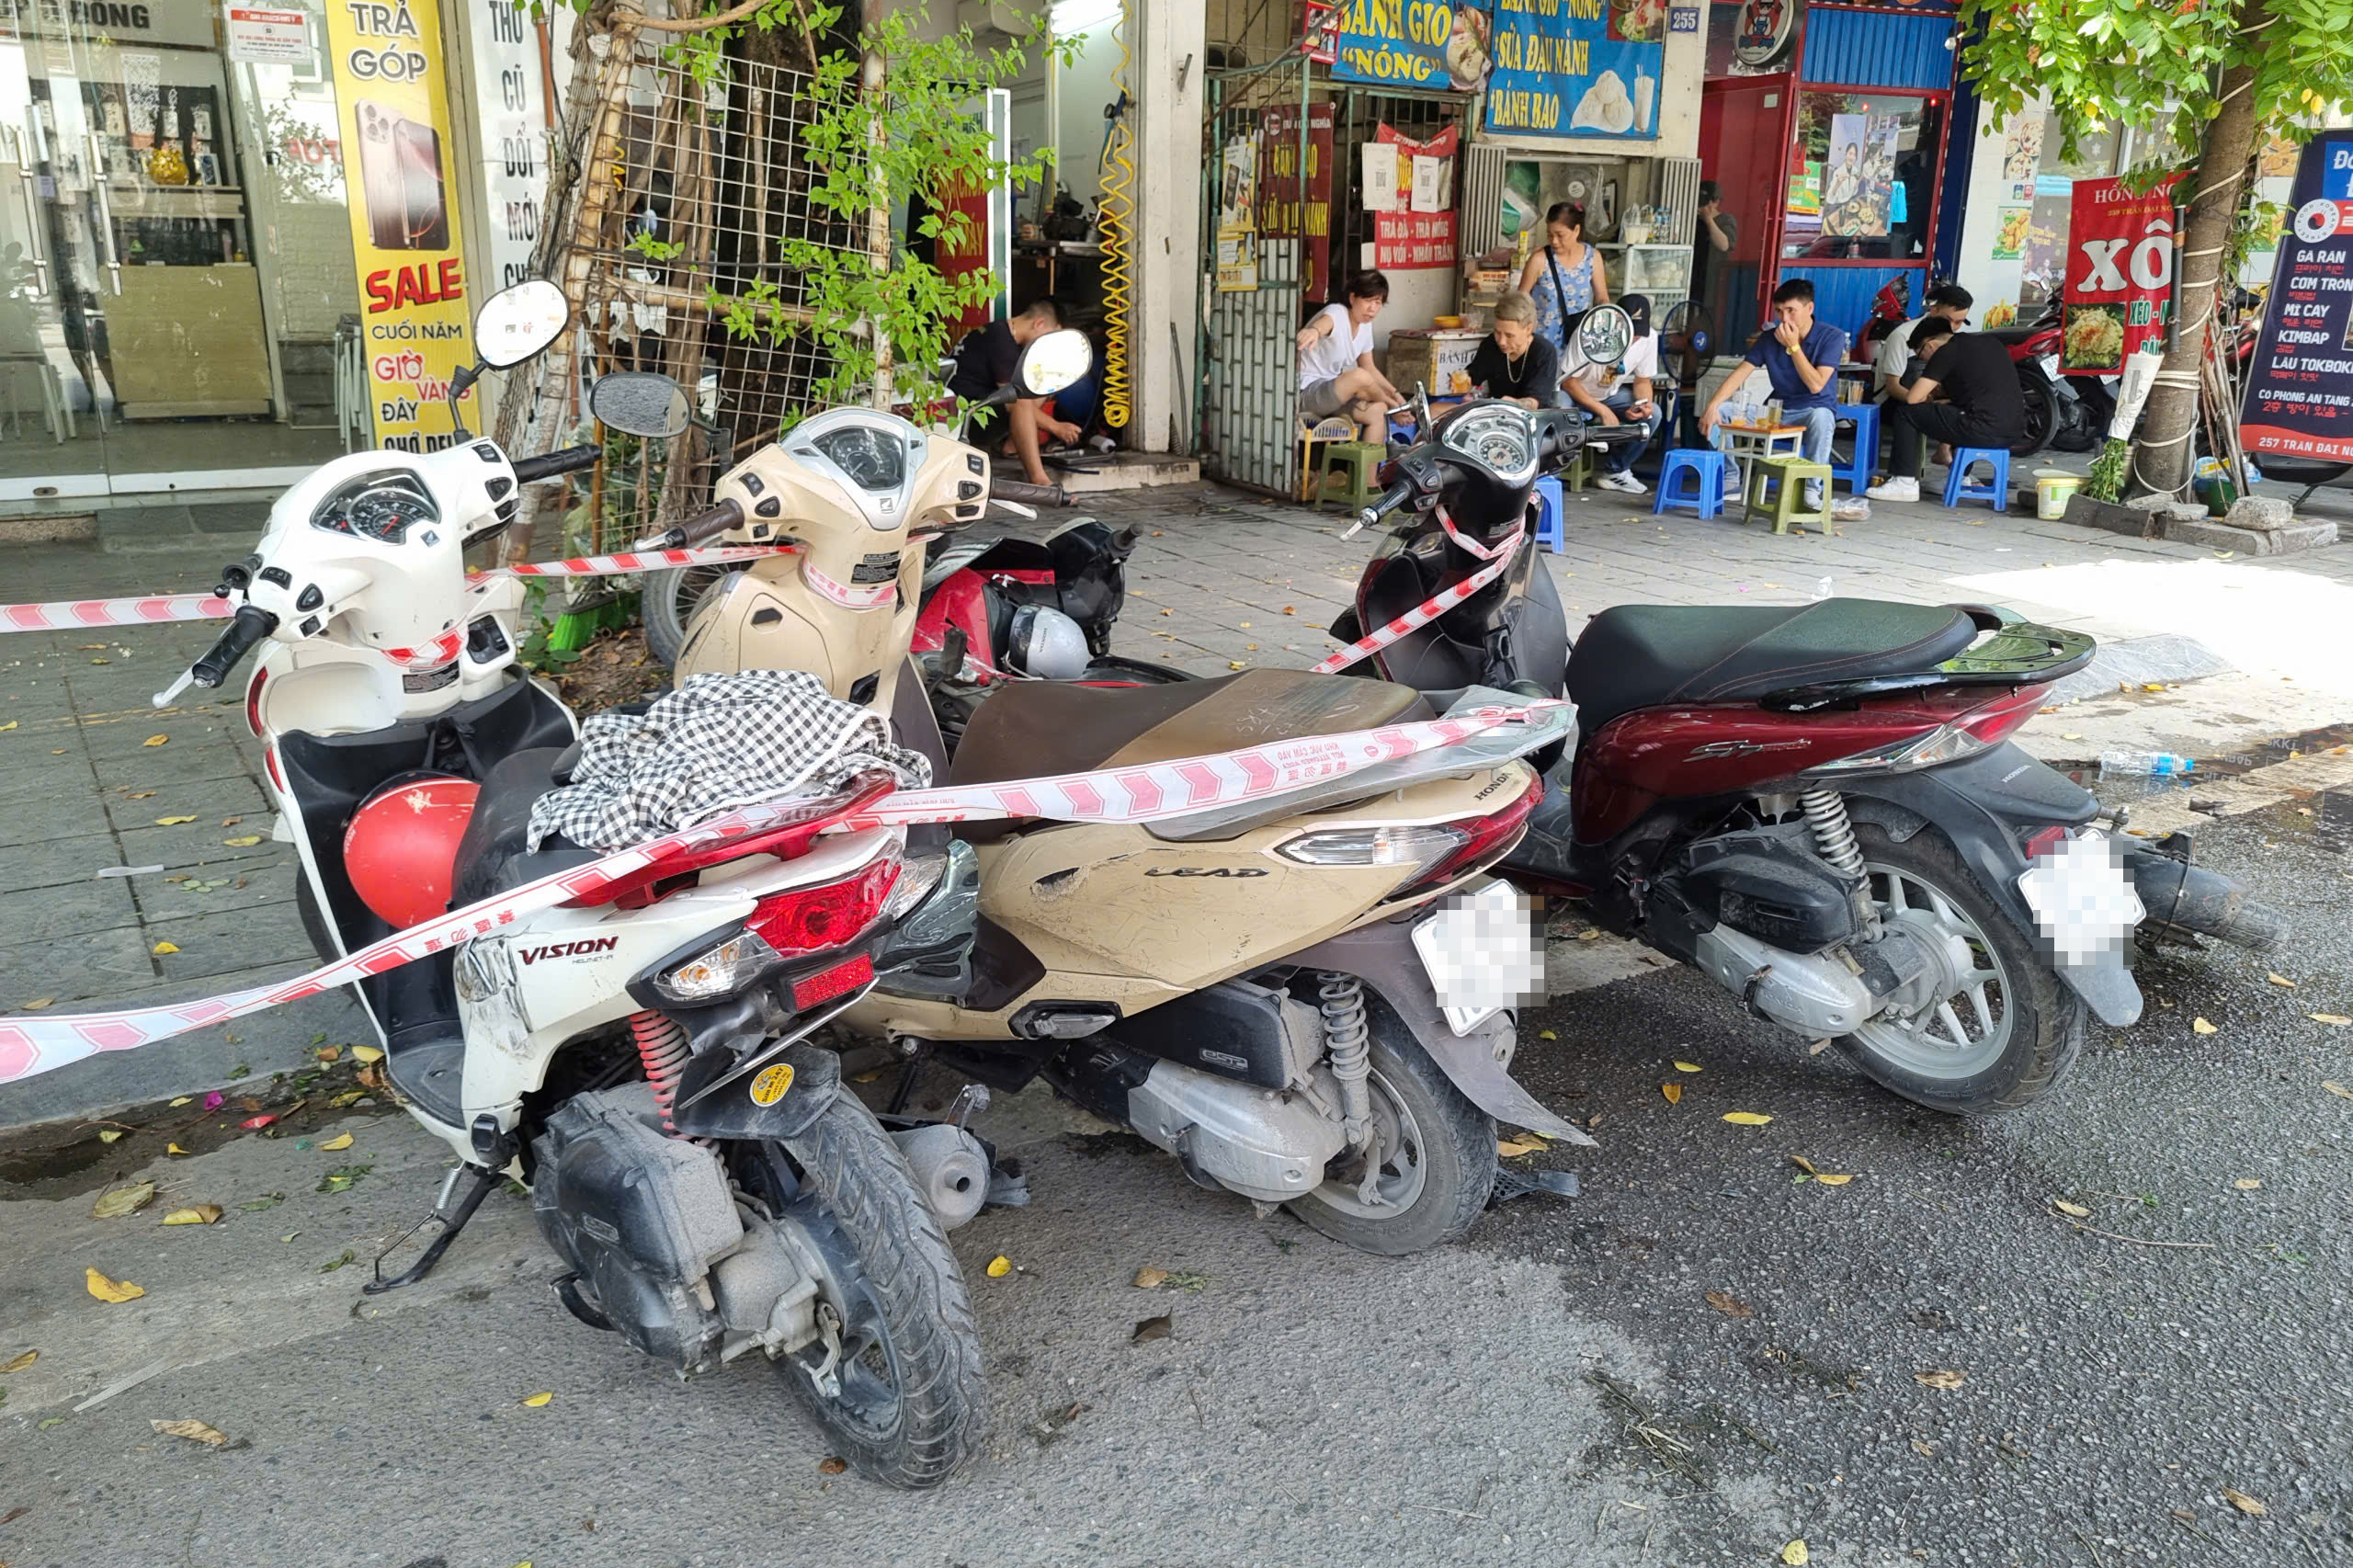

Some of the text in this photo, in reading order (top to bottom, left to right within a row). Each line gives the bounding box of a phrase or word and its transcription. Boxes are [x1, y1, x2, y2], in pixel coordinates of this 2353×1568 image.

[349, 0, 418, 36] TRẢ
[489, 0, 523, 44] THU
[1672, 12, 1697, 29] 255
[350, 43, 426, 80] GÓP
[502, 63, 527, 112] CŨ
[1531, 92, 1560, 130] BAO
[504, 121, 534, 177] ĐỔI
[366, 257, 463, 314] SALE
[2130, 295, 2151, 325] XÉO
[2302, 304, 2330, 318] CAY
[371, 319, 463, 340] CUỐI NĂM
[2278, 330, 2330, 345] KIMBAP
[375, 349, 423, 381] GIỜ
[2301, 358, 2353, 374] TOKBOK
[381, 396, 418, 422] ĐÂY
[2258, 437, 2279, 449] 257
[1473, 773, 1513, 801] HONDA
[1143, 866, 1270, 878] LEAD
[517, 936, 620, 965] VISION
